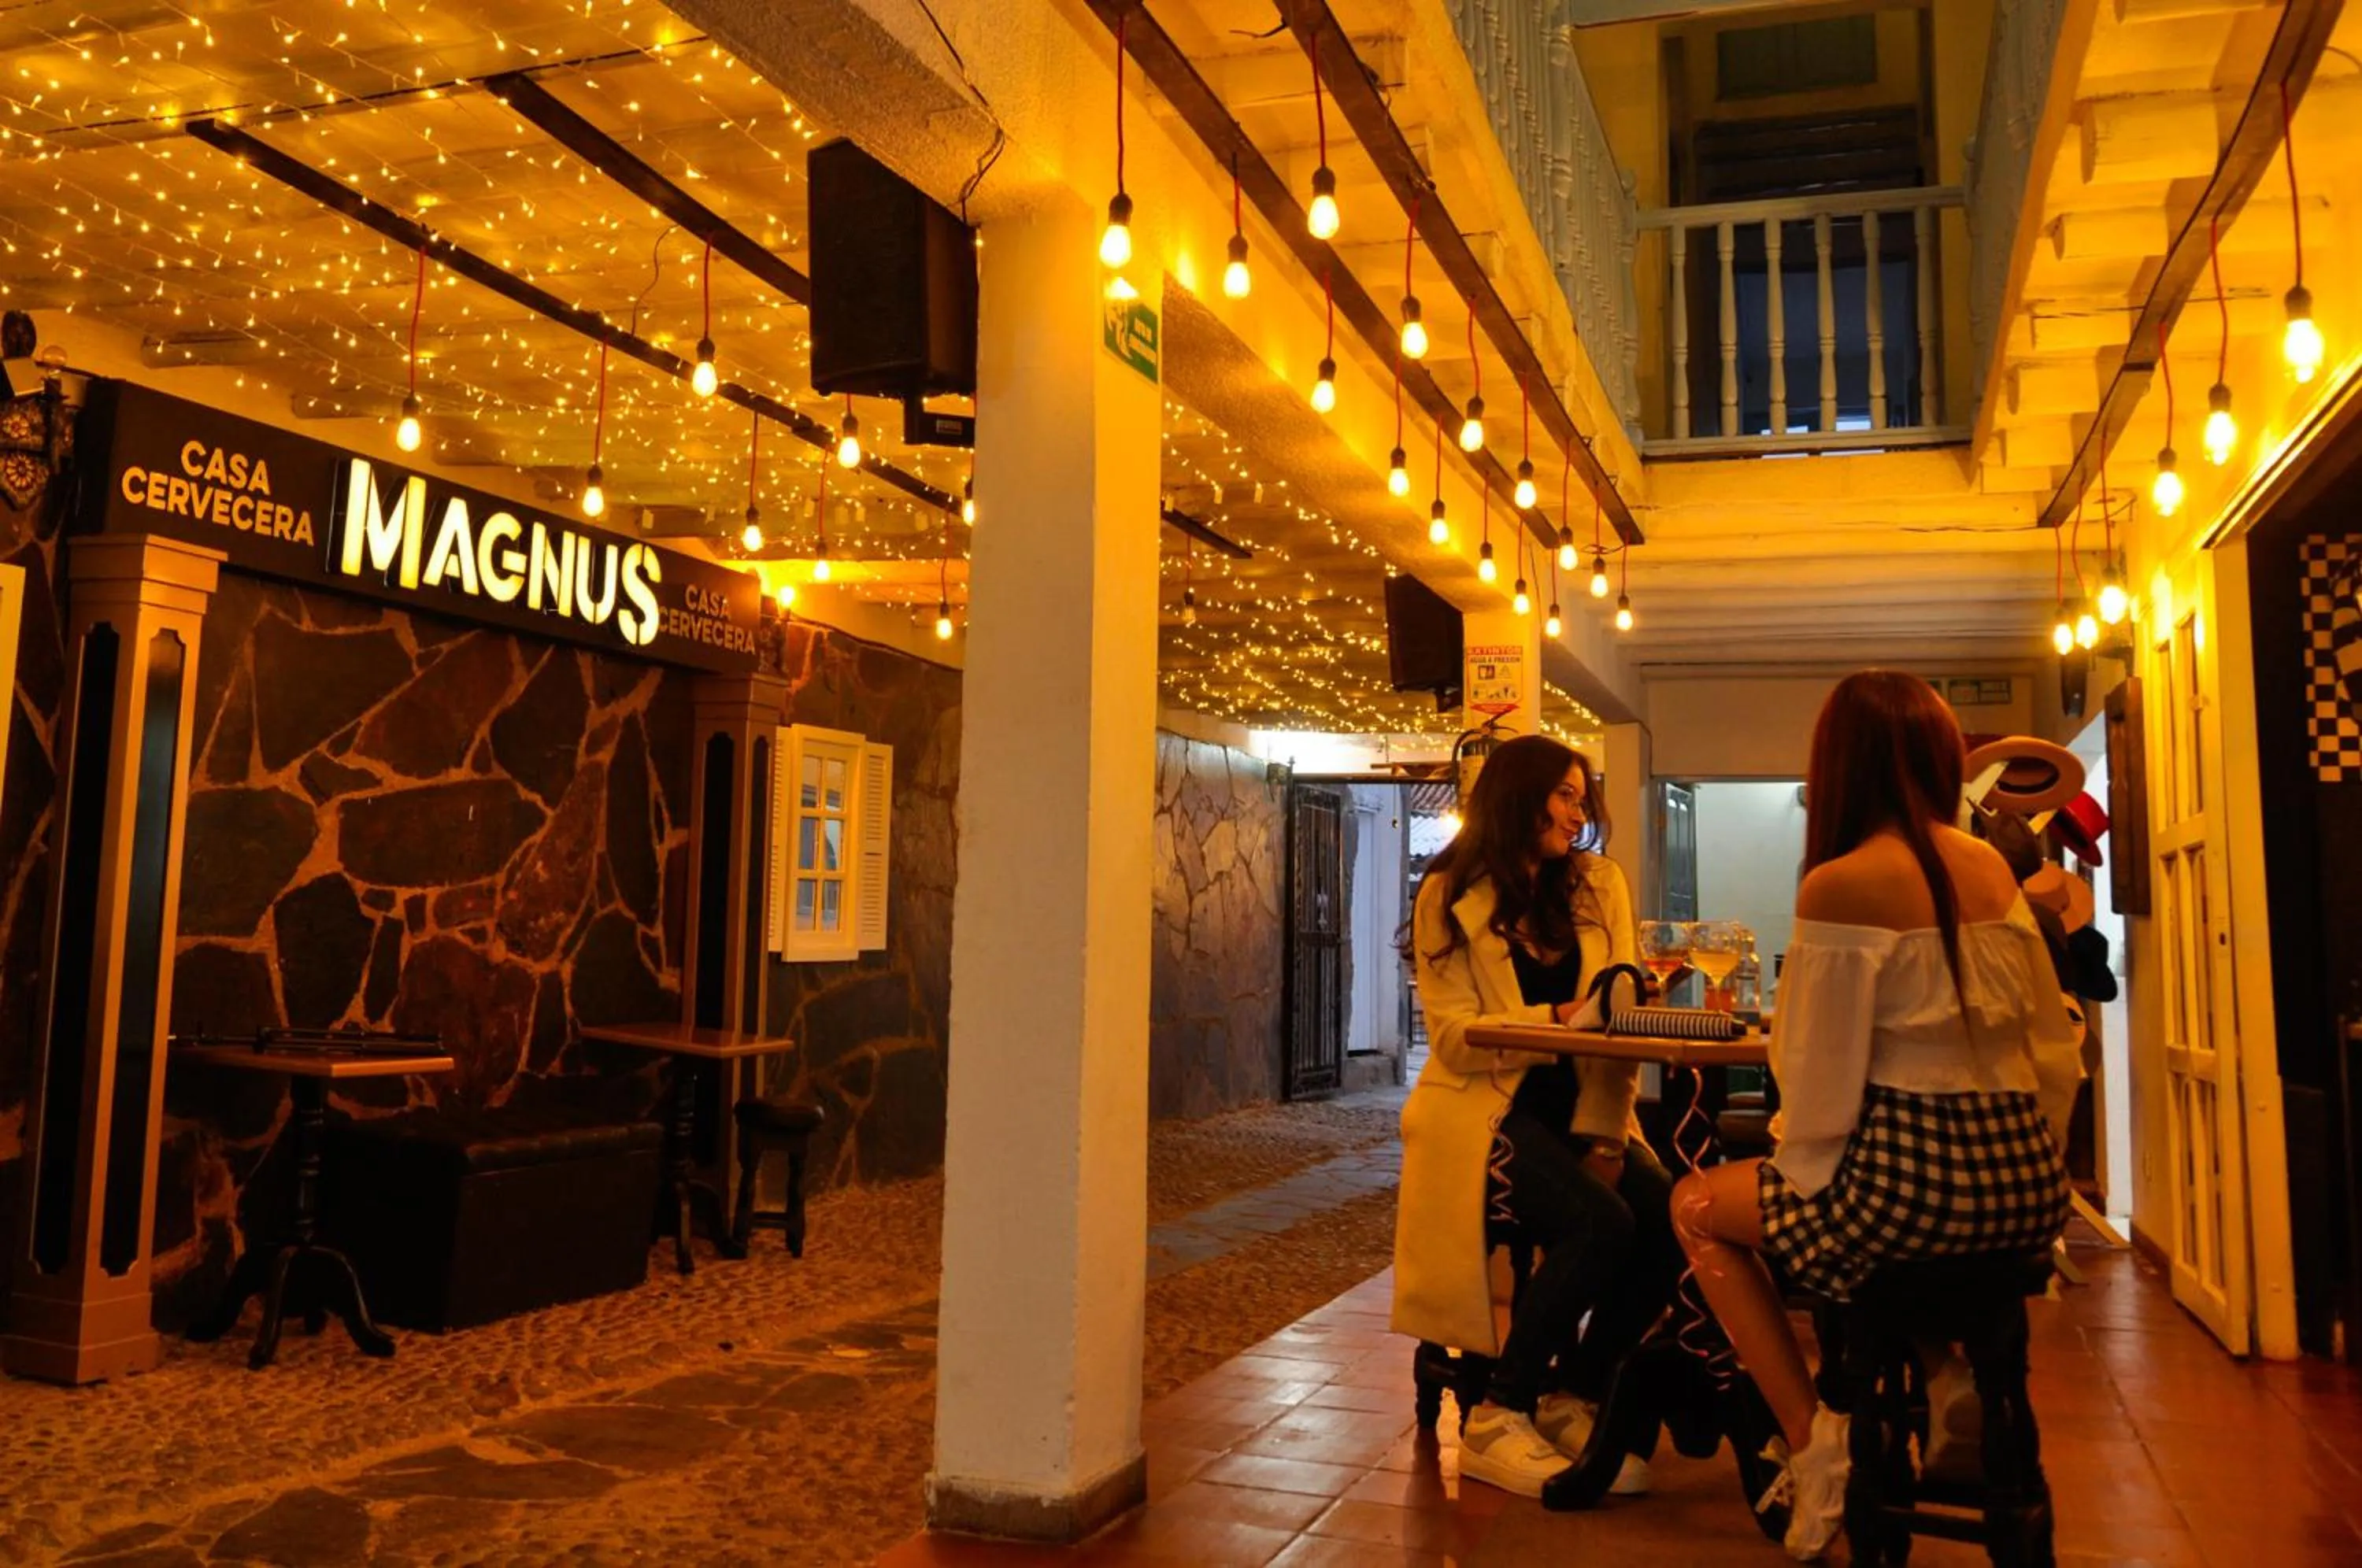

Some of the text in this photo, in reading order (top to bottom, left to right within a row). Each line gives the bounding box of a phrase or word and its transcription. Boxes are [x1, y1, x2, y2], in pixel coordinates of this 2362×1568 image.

[180, 440, 272, 496] CASA
[121, 466, 315, 547] CERVECERA
[341, 457, 662, 646] MAGNUS
[658, 605, 756, 655] CERVECERA
[685, 583, 731, 621] CASA
